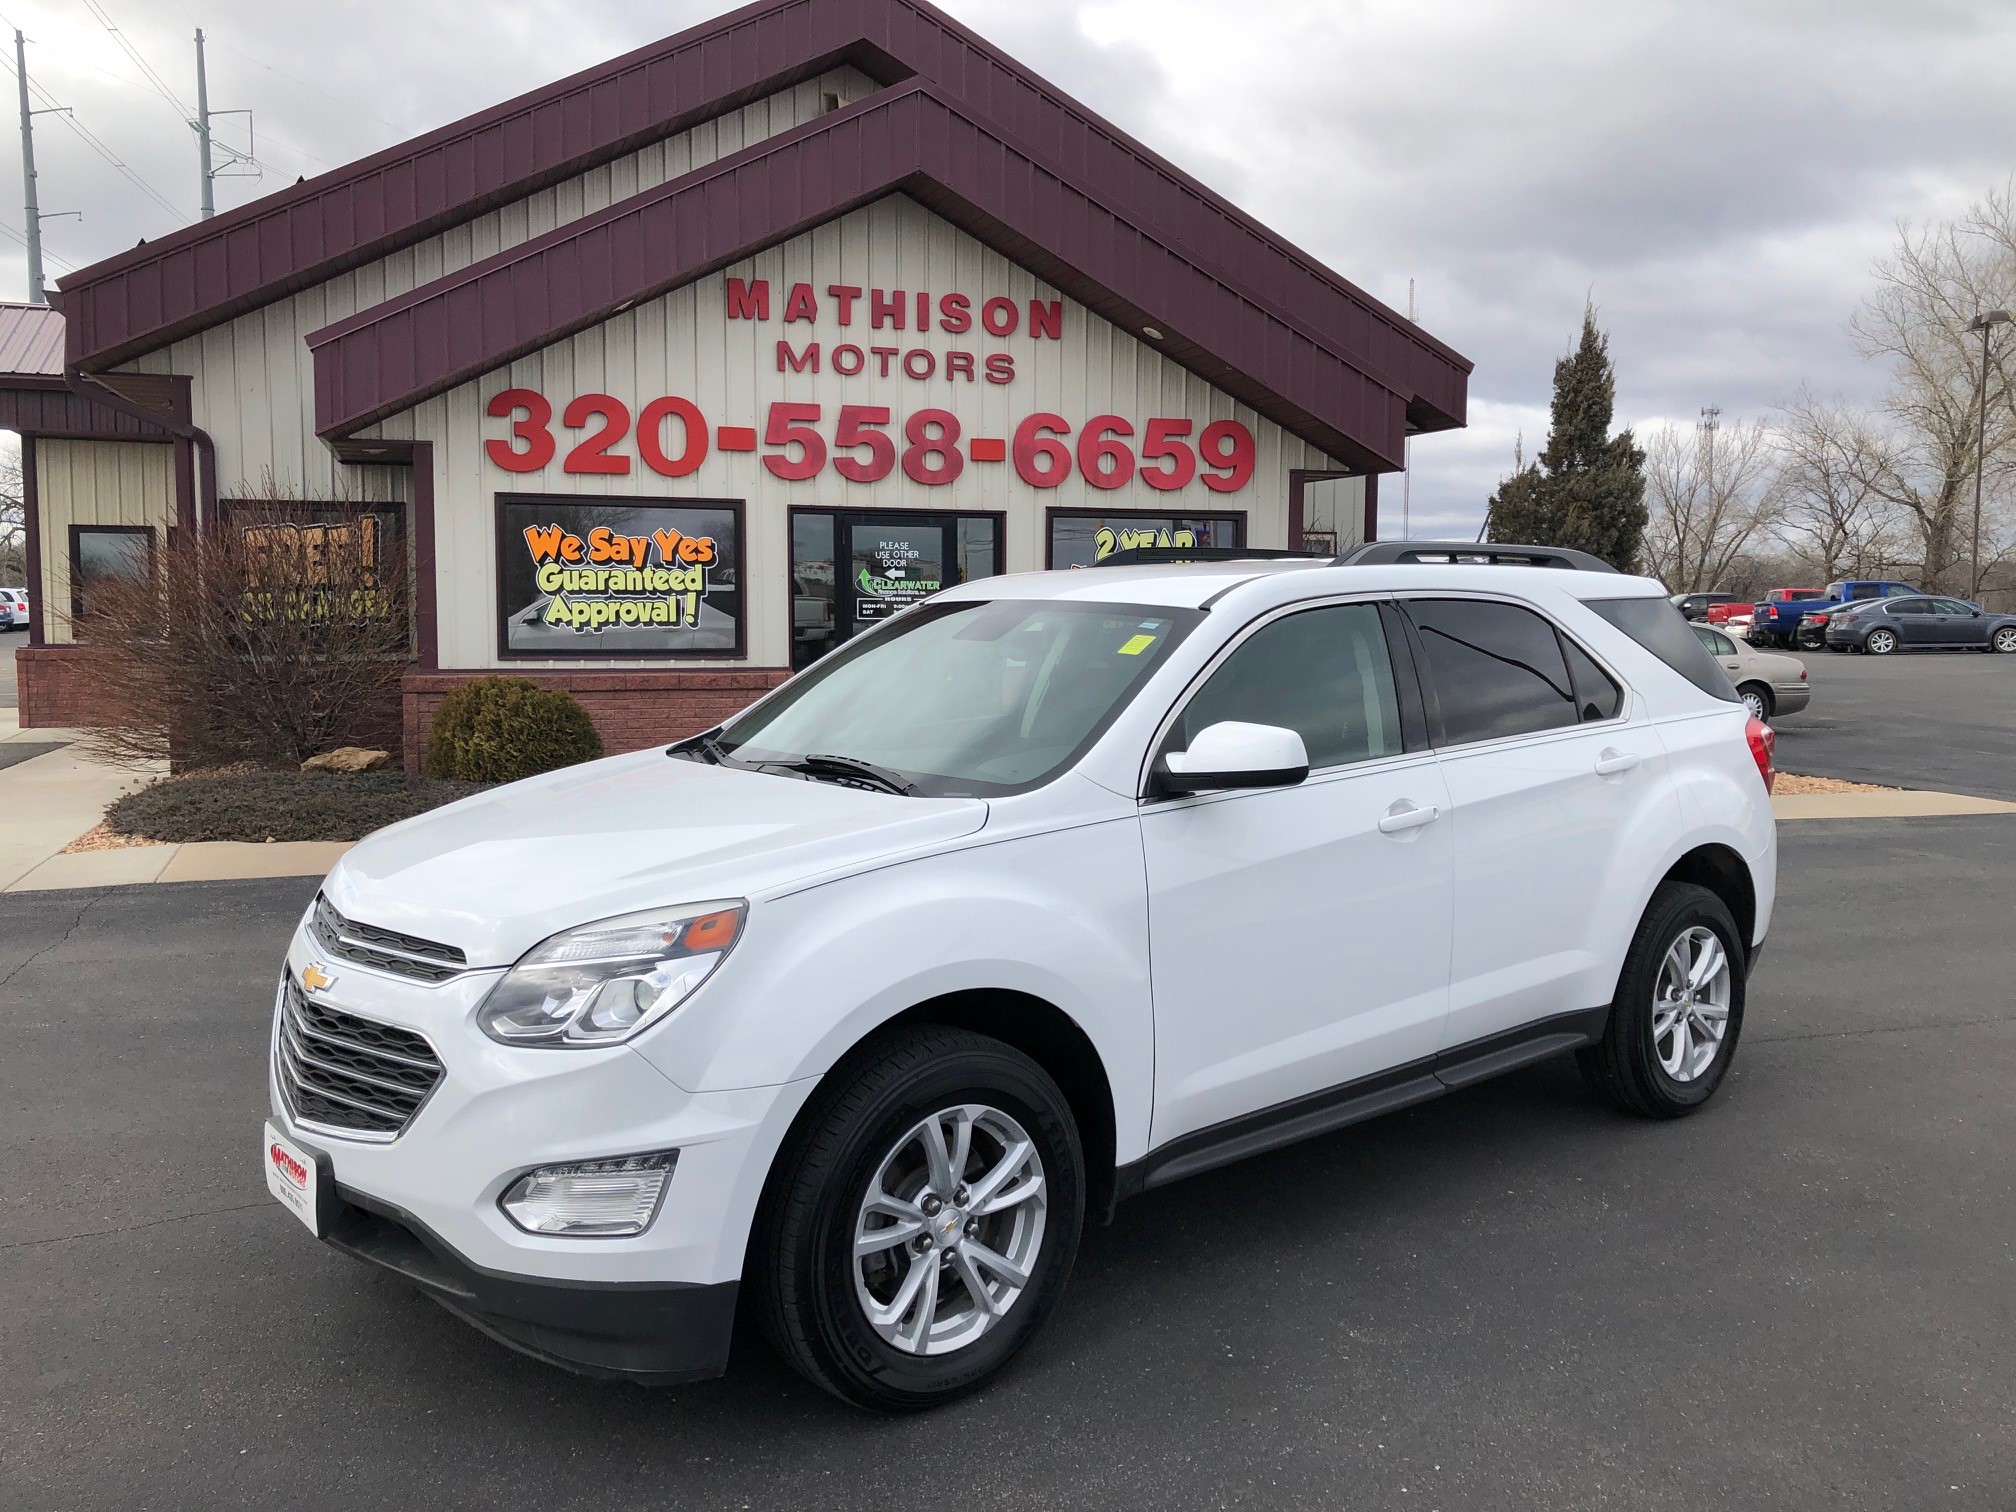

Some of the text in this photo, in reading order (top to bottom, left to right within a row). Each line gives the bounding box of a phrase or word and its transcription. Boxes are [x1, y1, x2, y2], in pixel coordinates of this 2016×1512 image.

[727, 278, 1062, 340] MATHISON
[776, 341, 1016, 385] MOTORS
[485, 388, 1256, 493] 320-558-6659
[524, 524, 715, 568] We Say Yes
[875, 550, 919, 559] USE OTHER
[879, 541, 909, 550] PLEASE
[1096, 527, 1116, 563] 2
[538, 564, 704, 592] Guaranteed
[882, 559, 907, 567] DOOR
[873, 579, 940, 590] CLEARWATER
